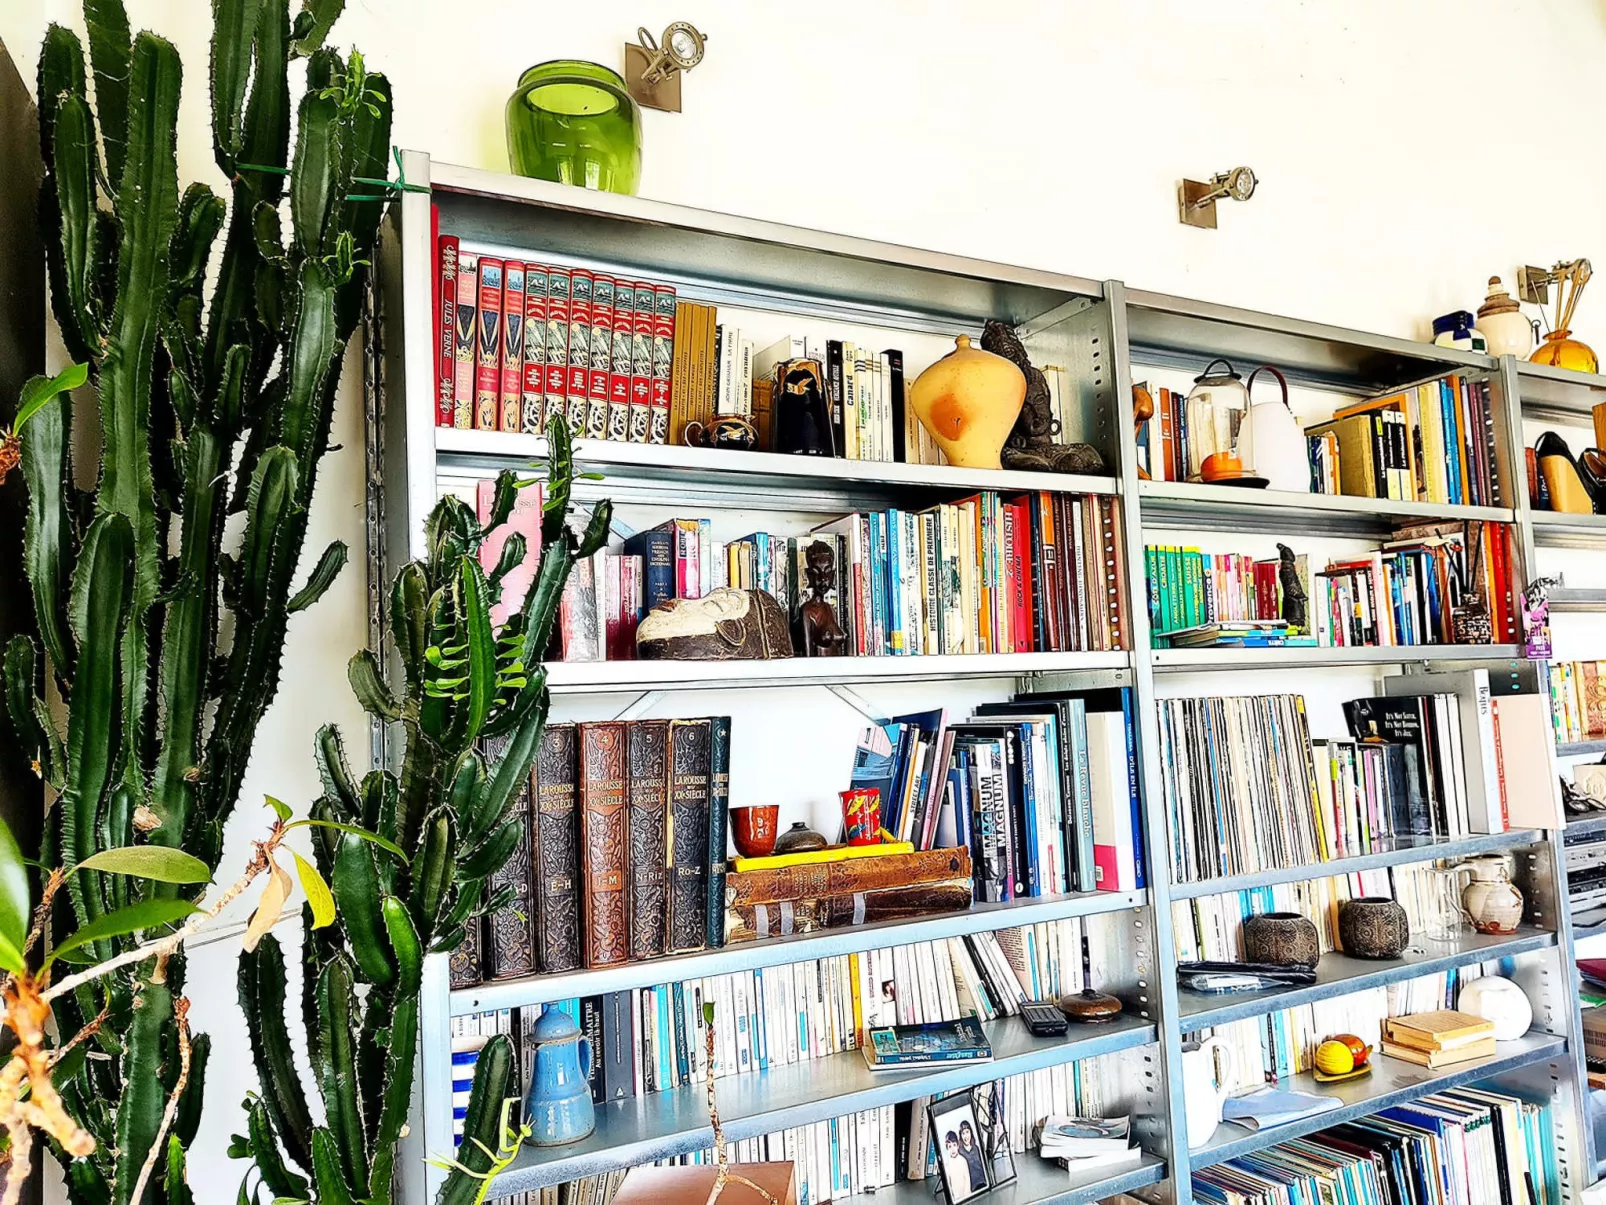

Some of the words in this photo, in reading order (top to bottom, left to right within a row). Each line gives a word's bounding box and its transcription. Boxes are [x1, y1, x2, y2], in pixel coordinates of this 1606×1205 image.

[444, 299, 452, 325] JULES
[444, 329, 452, 358] VERNE
[846, 375, 854, 406] Canard
[925, 518, 934, 555] PREMIERE
[1004, 512, 1013, 565] HISTOIRE
[927, 556, 934, 566] DE
[927, 568, 935, 596] CLASSE
[1171, 582, 1179, 624] ANGLETERRE
[928, 597, 936, 631] HISTOIRE
[600, 735, 609, 744] 4
[646, 734, 652, 743] 5
[688, 731, 695, 741] 6
[553, 738, 561, 748] 3
[1078, 750, 1086, 763] La
[589, 780, 623, 792] LAROUSSE
[674, 774, 706, 785] LAROUSSE
[914, 774, 922, 787] ART
[1079, 766, 1088, 796] Revue
[686, 787, 706, 800] SIÈCLE
[1130, 786, 1138, 798] ÎLE
[909, 785, 920, 814] STREET
[981, 776, 996, 849] MAGNUM
[993, 774, 1006, 847] MAGNUM
[1081, 799, 1091, 837] blanche
[636, 871, 663, 882] N-Riz
[678, 866, 701, 876] Ro-Z
[551, 879, 571, 891] E-H
[595, 1059, 601, 1068] Au
